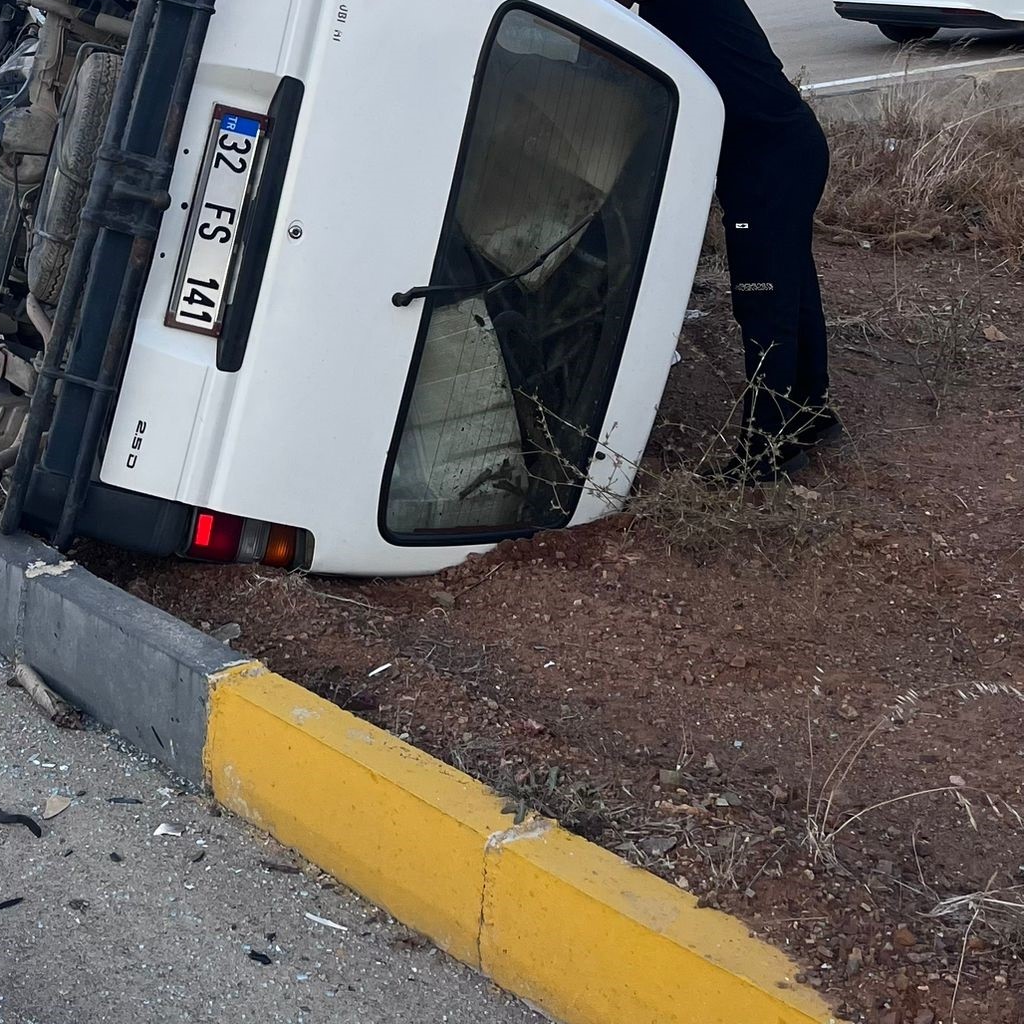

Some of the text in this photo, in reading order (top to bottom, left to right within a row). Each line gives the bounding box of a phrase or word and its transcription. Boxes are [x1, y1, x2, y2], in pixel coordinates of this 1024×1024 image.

[179, 116, 252, 323] TR 32 FS 141
